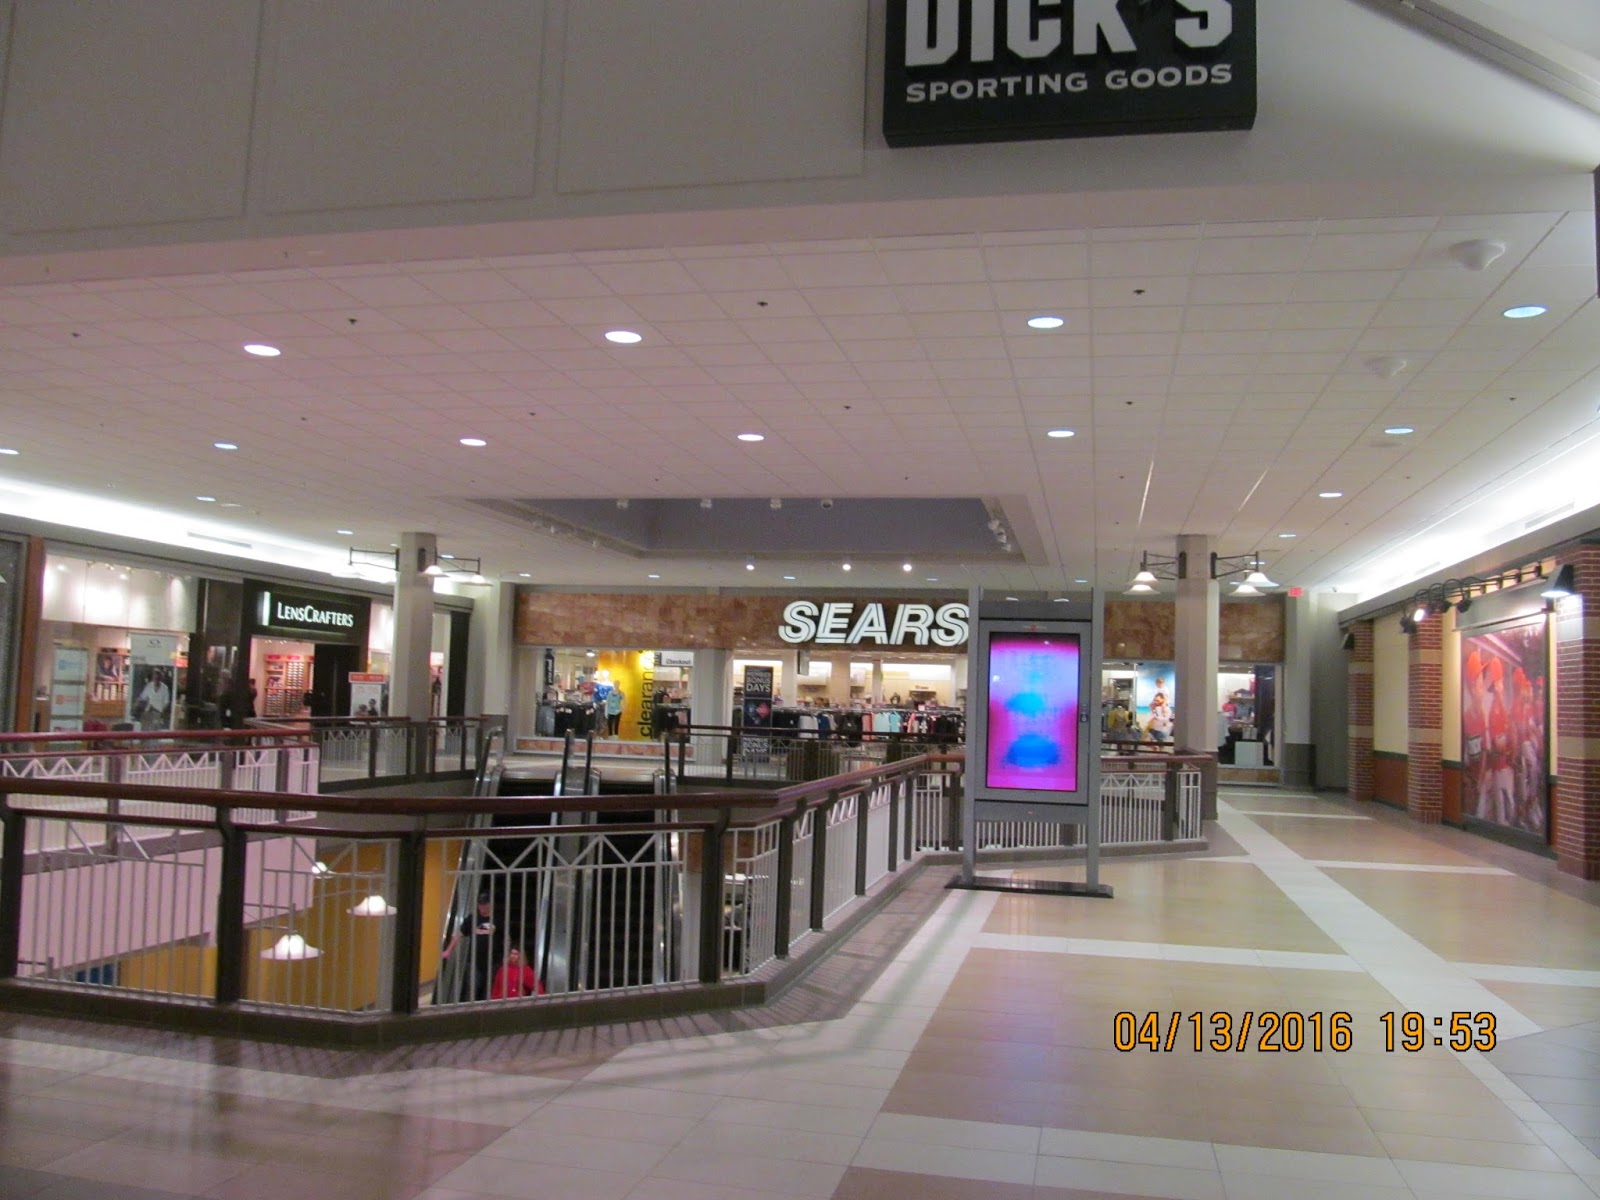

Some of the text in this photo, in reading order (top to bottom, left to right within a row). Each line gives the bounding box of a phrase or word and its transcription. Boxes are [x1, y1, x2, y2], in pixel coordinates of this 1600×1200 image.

[906, 63, 1233, 103] SPORTING GOODS
[778, 600, 970, 647] SEARS
[746, 683, 771, 693] DAYS
